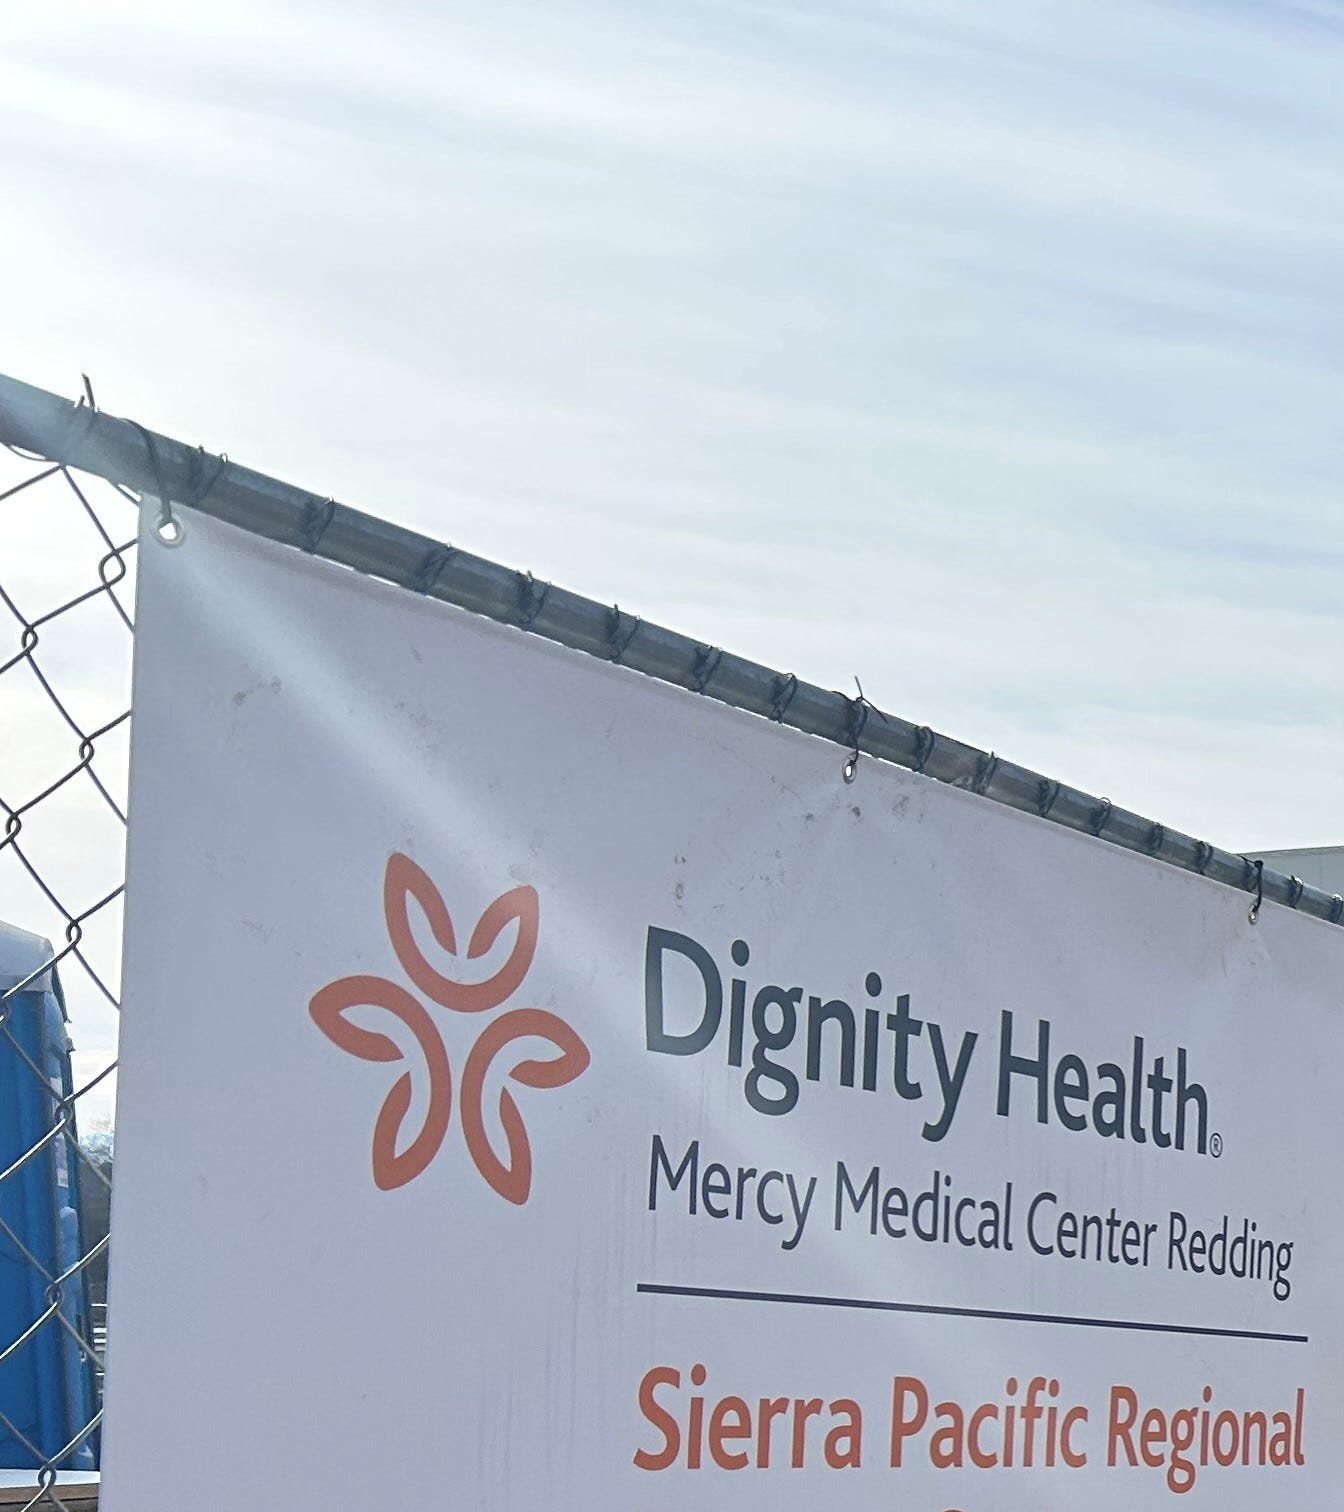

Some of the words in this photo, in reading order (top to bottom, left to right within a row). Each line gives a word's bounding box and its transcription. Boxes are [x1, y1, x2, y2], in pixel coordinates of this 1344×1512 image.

[644, 926, 978, 1142] Dignity
[648, 1134, 817, 1250] Mercy
[834, 1160, 1014, 1251] Medical
[1027, 1192, 1158, 1267] Center
[1167, 1212, 1294, 1301] Redding
[633, 1364, 862, 1471] Sierra
[890, 1376, 1088, 1469] Pacific
[1106, 1386, 1305, 1493] Regional
